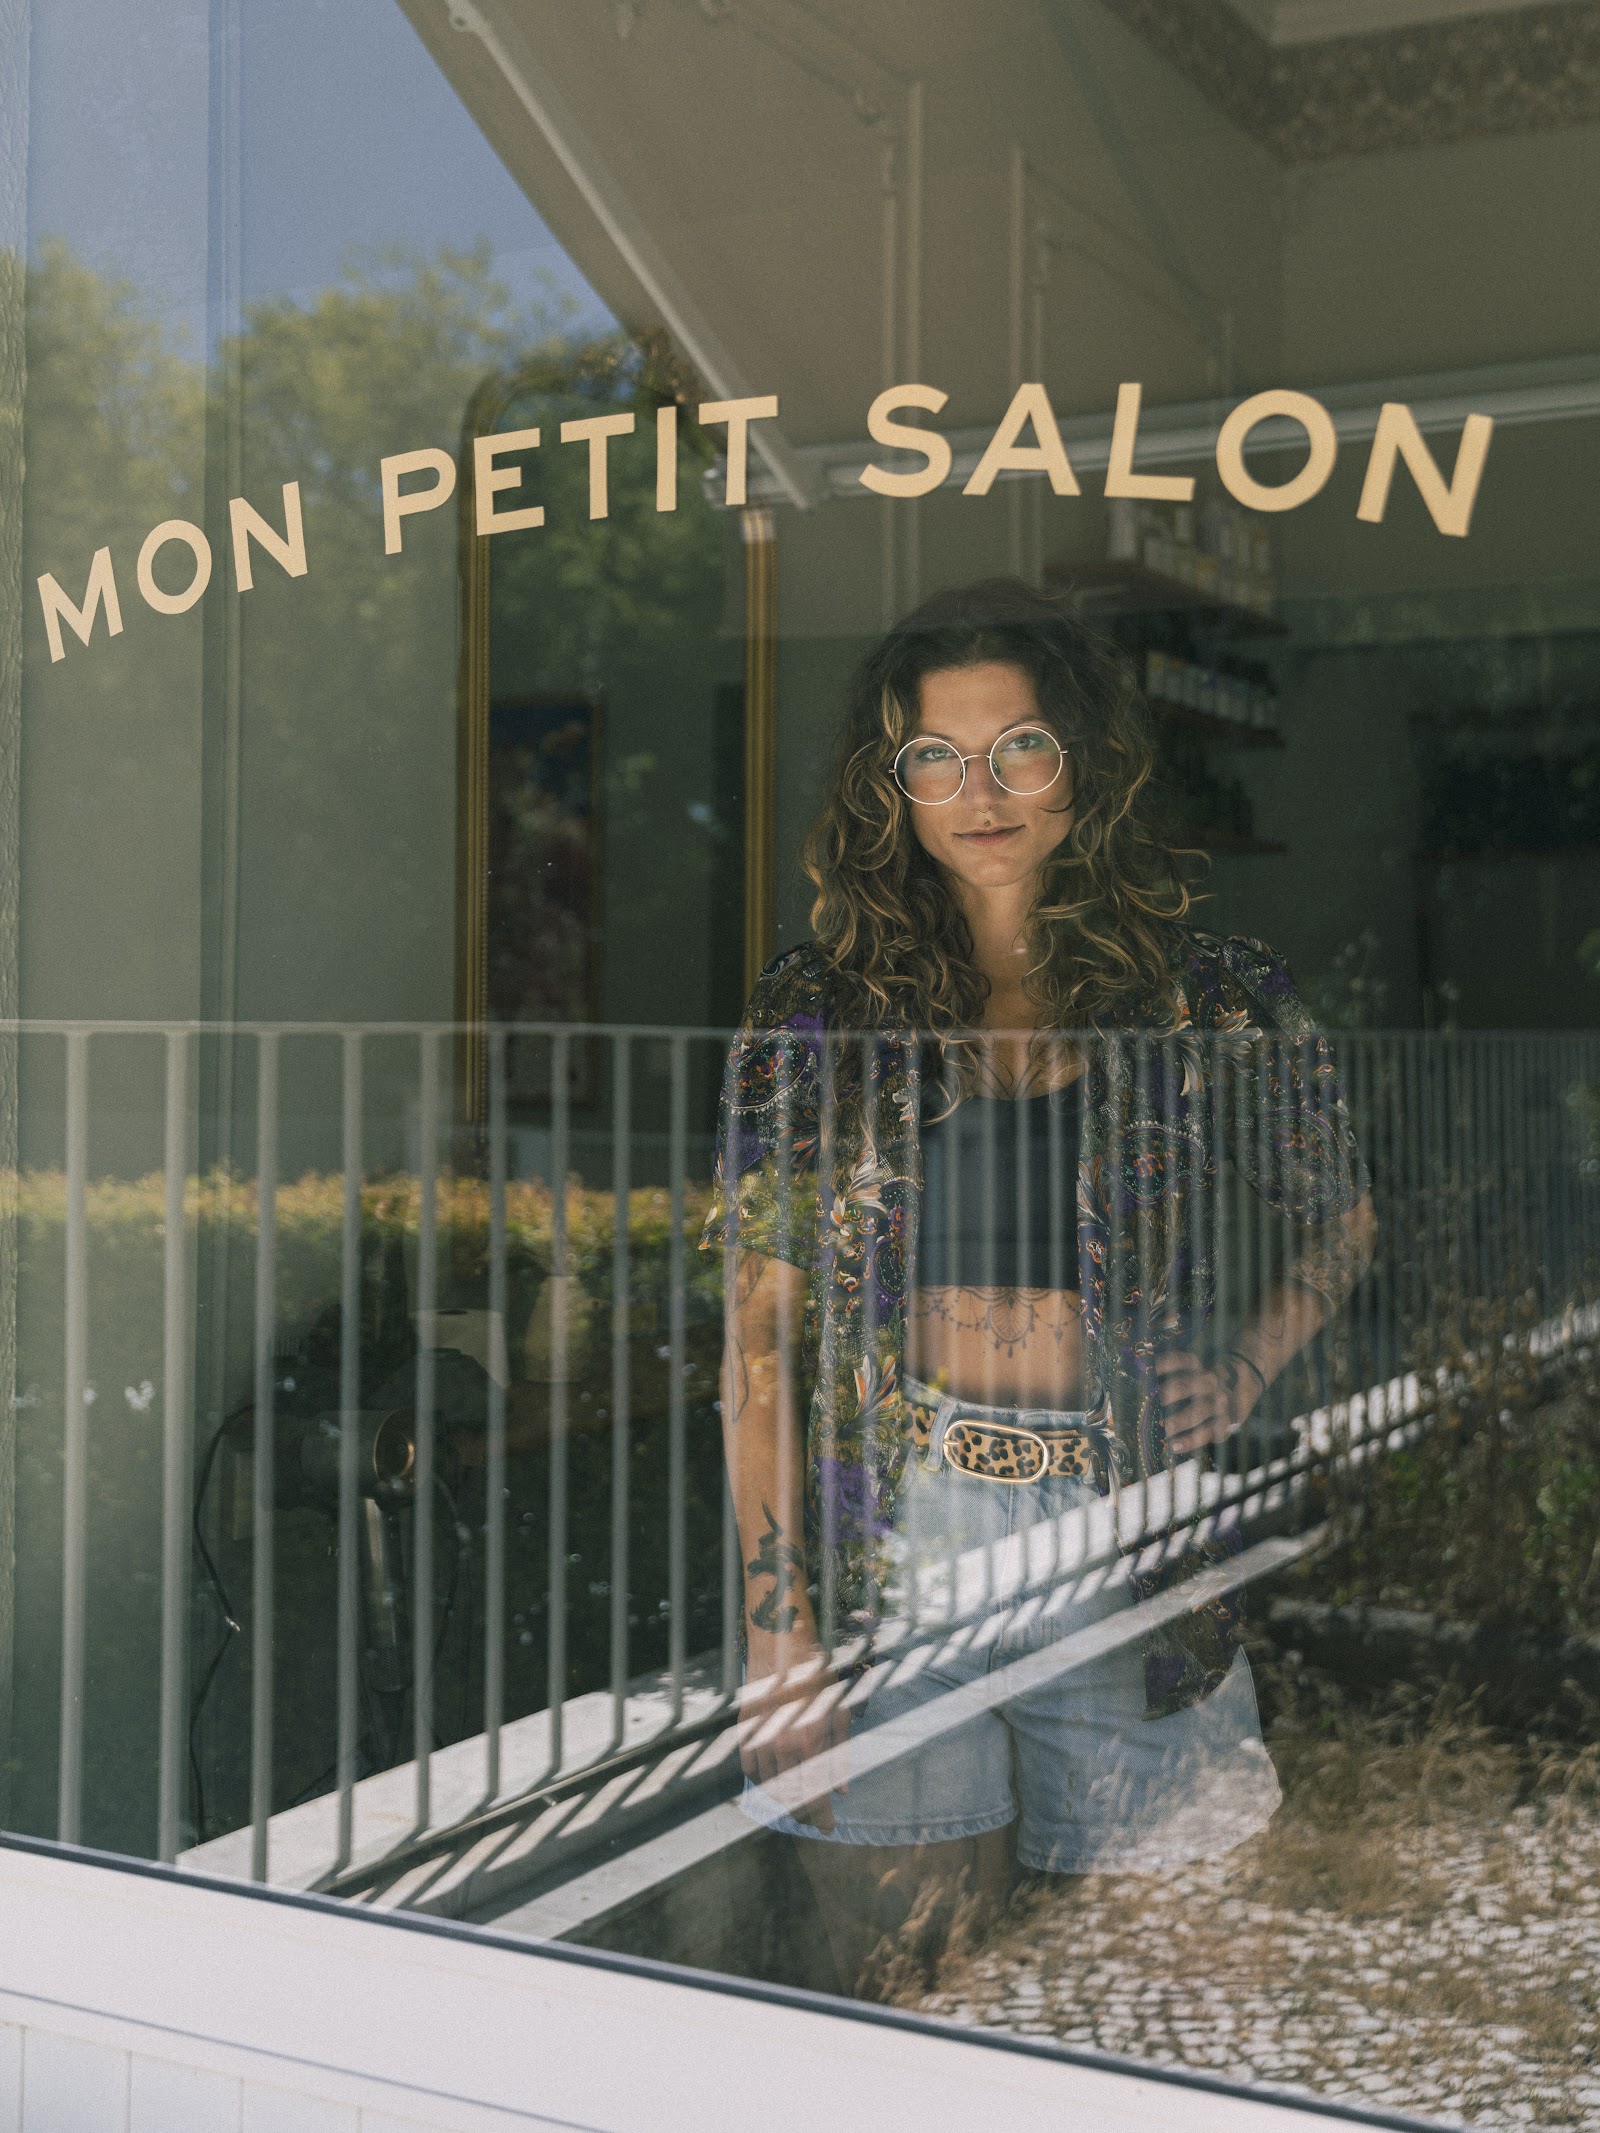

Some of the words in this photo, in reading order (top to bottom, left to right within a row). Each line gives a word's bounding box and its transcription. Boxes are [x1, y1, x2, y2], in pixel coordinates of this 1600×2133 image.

[37, 480, 309, 664] MON
[380, 395, 779, 556] PETIT
[859, 382, 1494, 538] SALON
